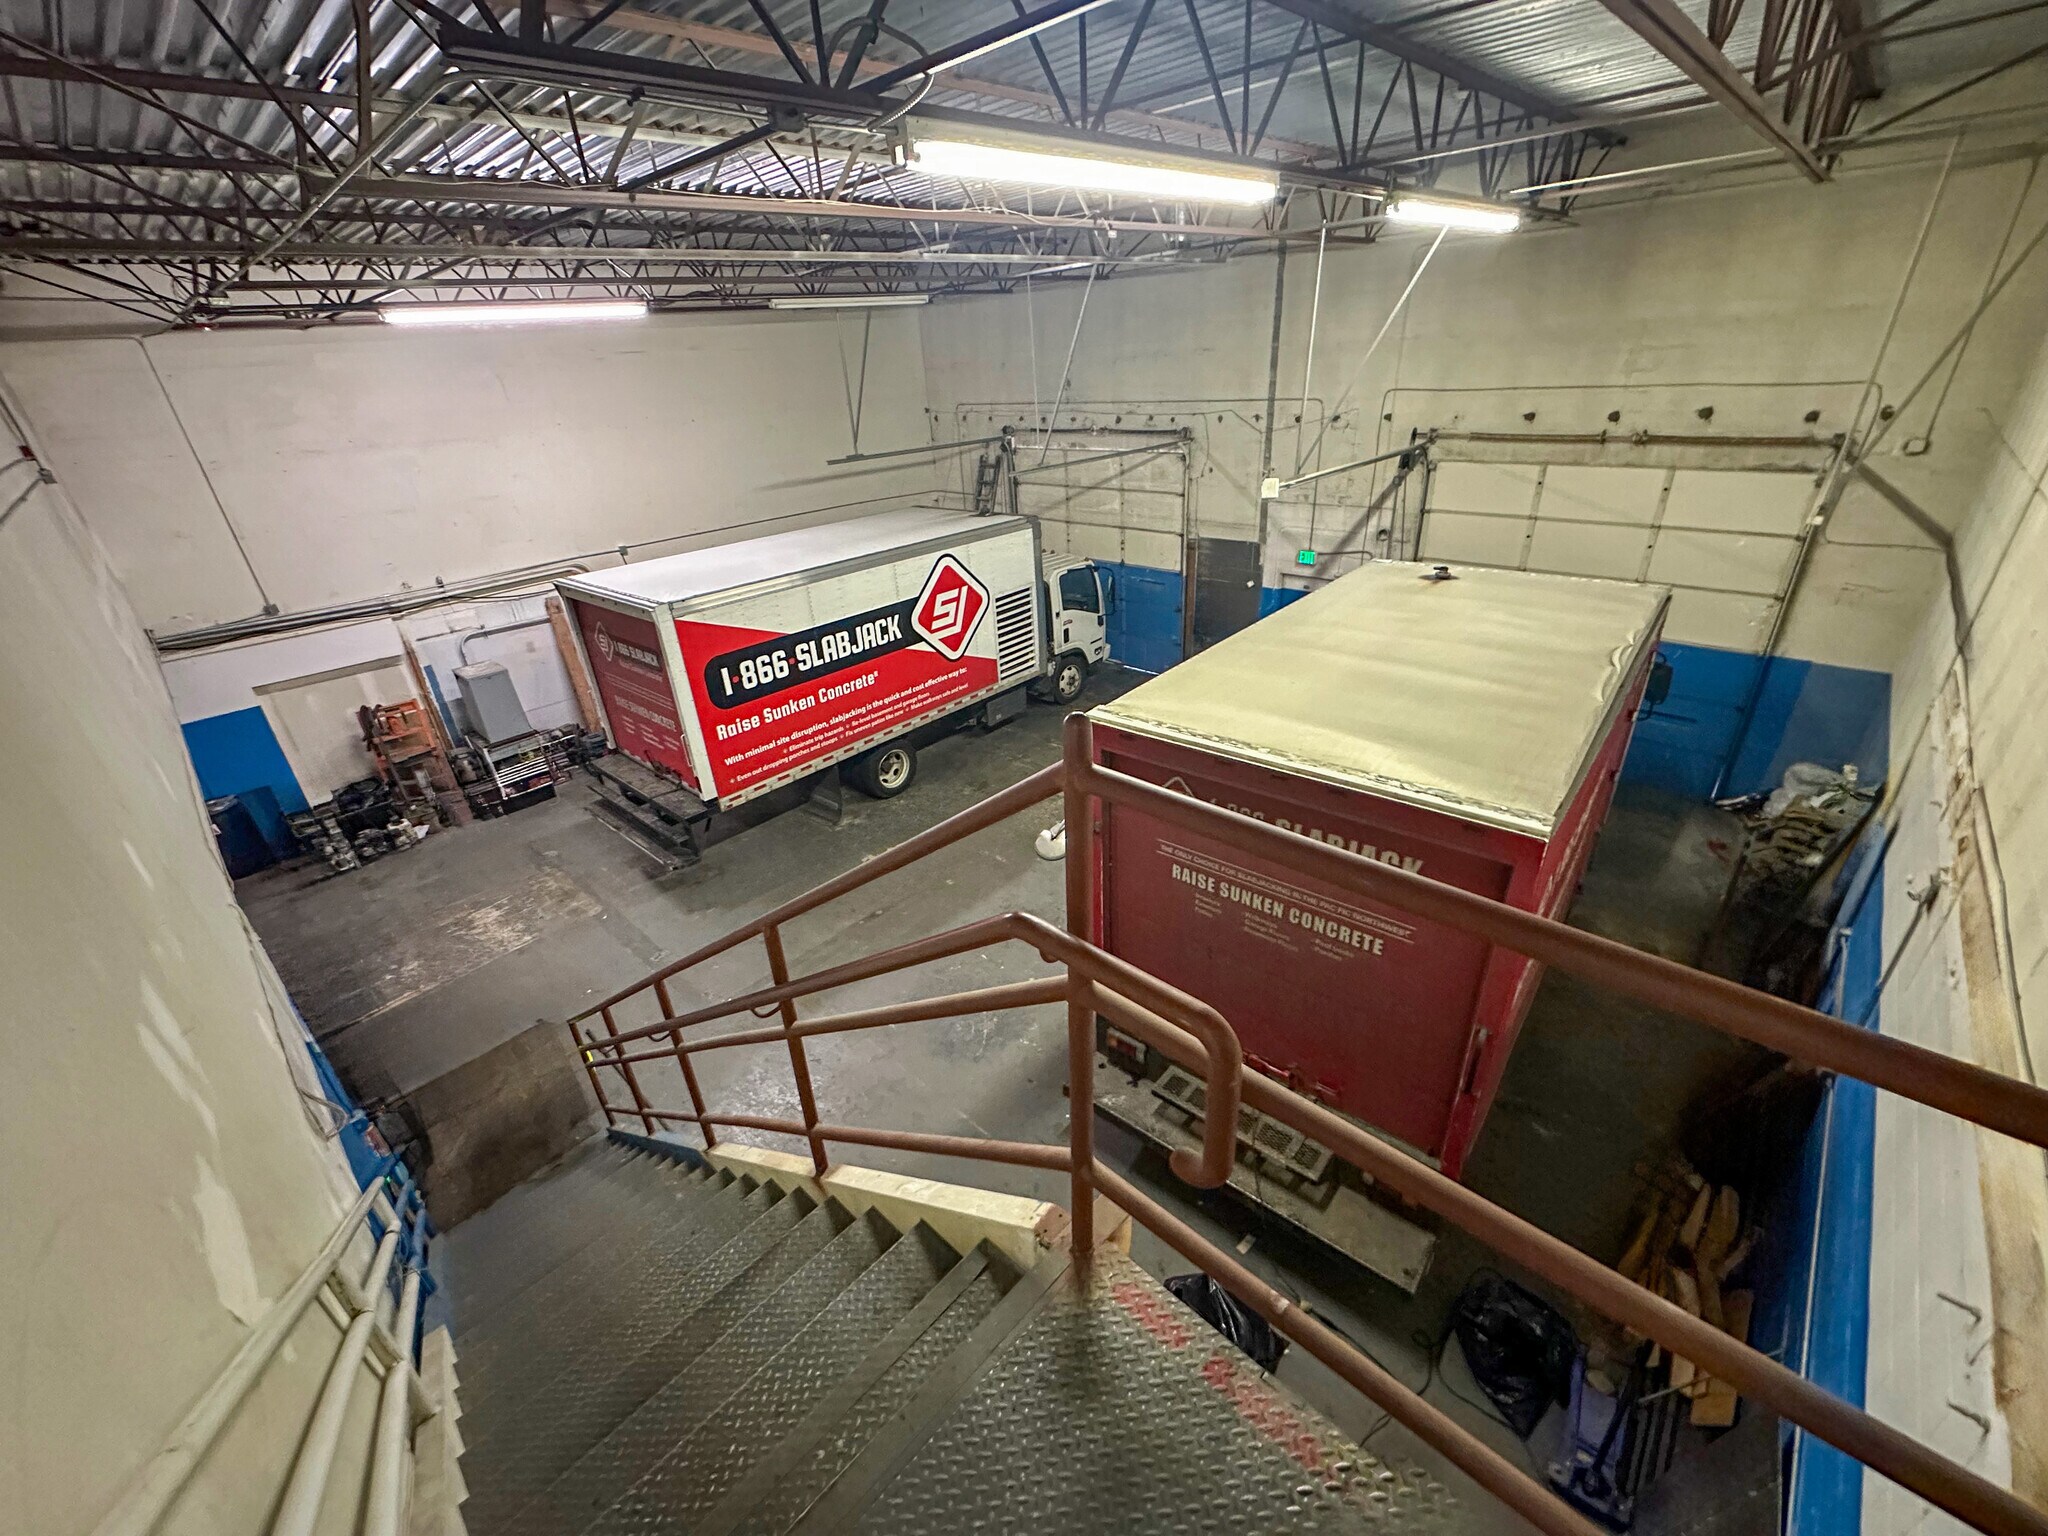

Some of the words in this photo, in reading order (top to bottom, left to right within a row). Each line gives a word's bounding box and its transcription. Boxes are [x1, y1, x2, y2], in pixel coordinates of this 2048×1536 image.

[717, 716, 760, 741] Raise
[763, 694, 816, 723] Sunken
[724, 753, 745, 766] With
[745, 740, 776, 758] minimal
[777, 736, 790, 747] site
[791, 721, 829, 740] disruption,
[830, 707, 867, 725] slabjacking
[866, 703, 872, 711] is
[872, 699, 883, 708] the
[883, 692, 900, 704] quick
[901, 687, 912, 697] and
[912, 683, 924, 692] cost
[925, 674, 948, 687] effective
[948, 670, 960, 678] way
[737, 772, 752, 782] Even
[752, 767, 763, 775] out
[810, 743, 820, 751] and
[1221, 865, 1236, 876] FOR
[1172, 863, 1215, 892] RAISE
[1219, 881, 1284, 918] SUNKEN
[1290, 907, 1384, 955] CONCRETE
